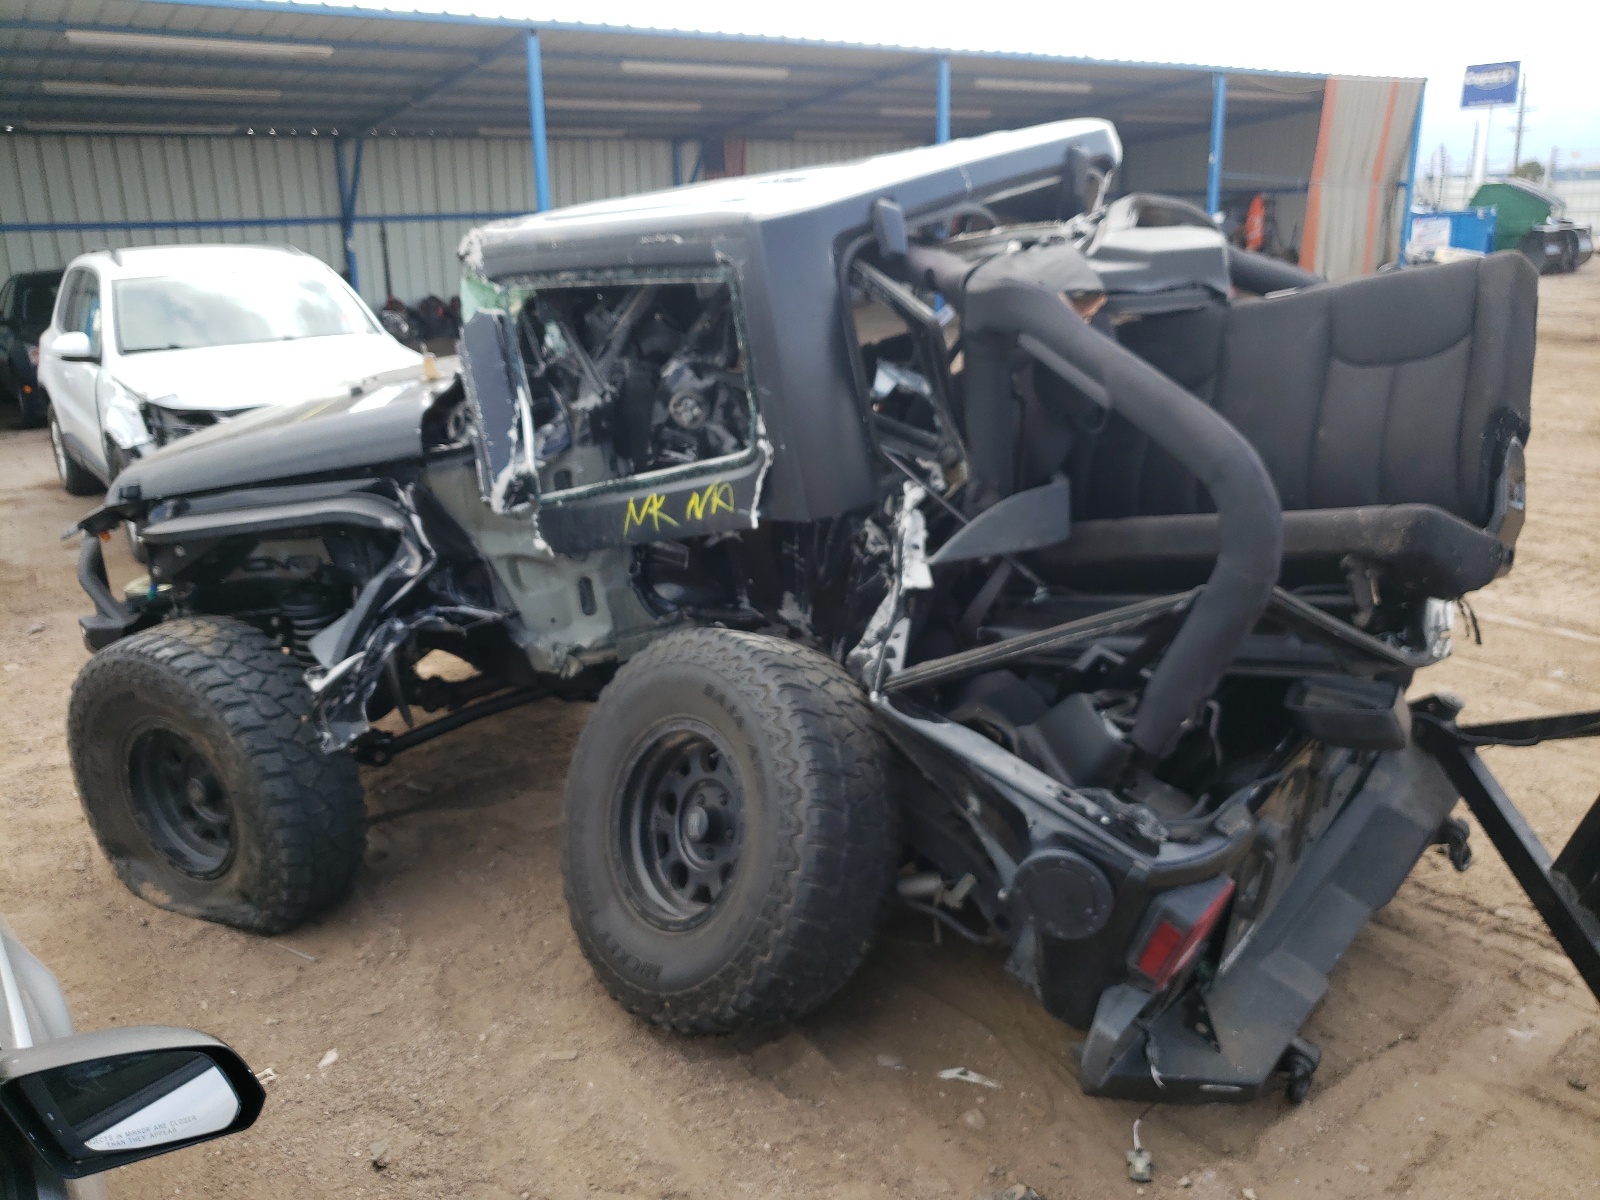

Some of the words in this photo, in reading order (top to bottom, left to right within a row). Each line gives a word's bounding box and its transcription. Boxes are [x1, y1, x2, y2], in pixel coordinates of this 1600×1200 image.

[125, 1127, 150, 1137] MIRROR
[153, 1122, 167, 1131] ARE
[170, 1115, 197, 1126] CLOSER
[150, 1127, 177, 1139] APPEAR
